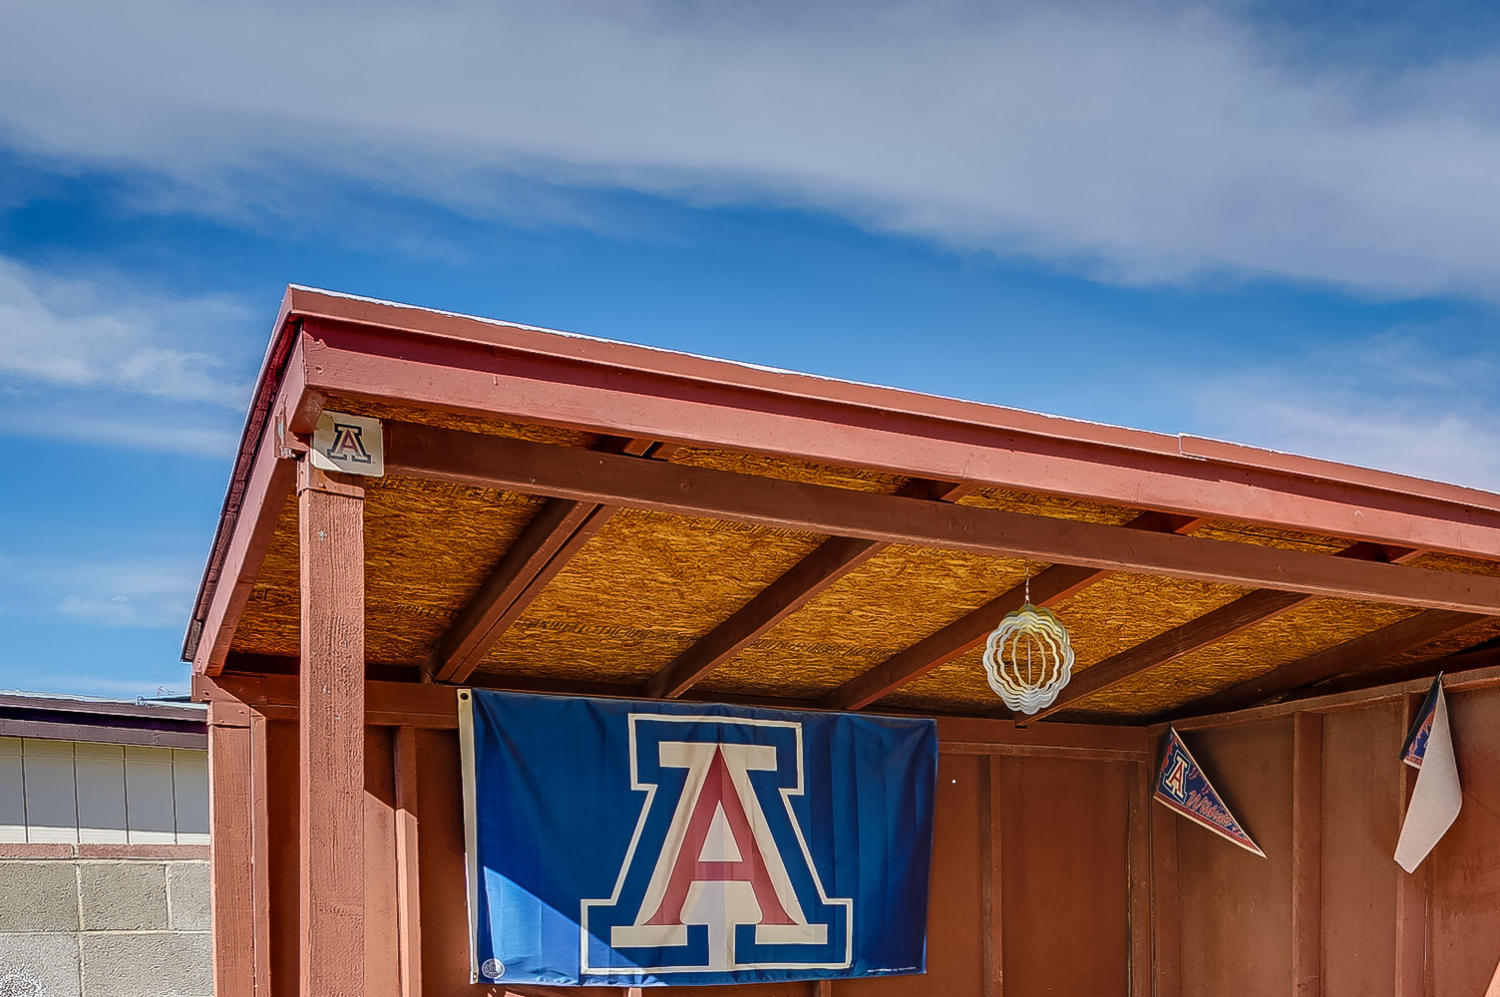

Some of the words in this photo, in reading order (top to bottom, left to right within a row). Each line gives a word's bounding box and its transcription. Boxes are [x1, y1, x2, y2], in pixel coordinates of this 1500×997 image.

[327, 423, 371, 464] A
[1163, 750, 1191, 805] A
[581, 713, 853, 974] A
